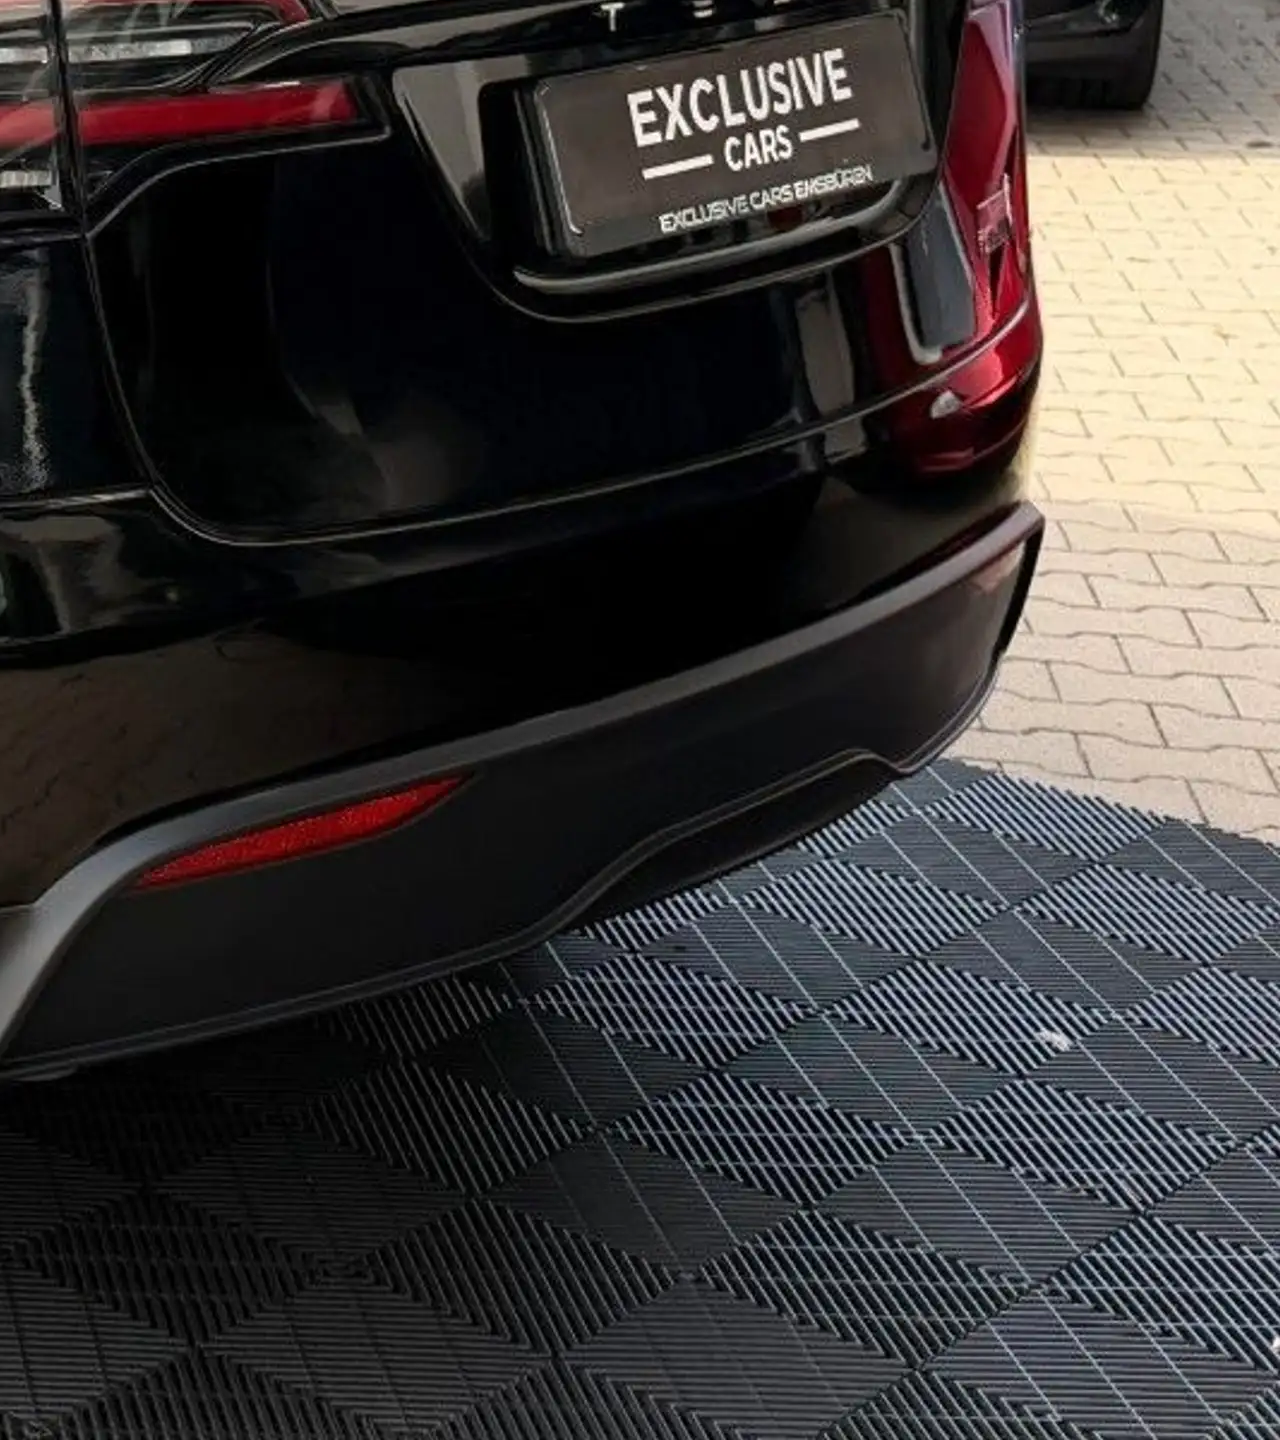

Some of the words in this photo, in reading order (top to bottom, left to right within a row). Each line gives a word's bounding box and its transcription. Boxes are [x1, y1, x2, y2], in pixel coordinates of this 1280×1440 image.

[627, 48, 853, 147] EXCLUSIVE
[724, 124, 793, 172] CARS
[658, 195, 749, 234] EXCLUSIVE
[749, 183, 793, 210] CARS
[794, 159, 873, 200] EMSBÜREN
